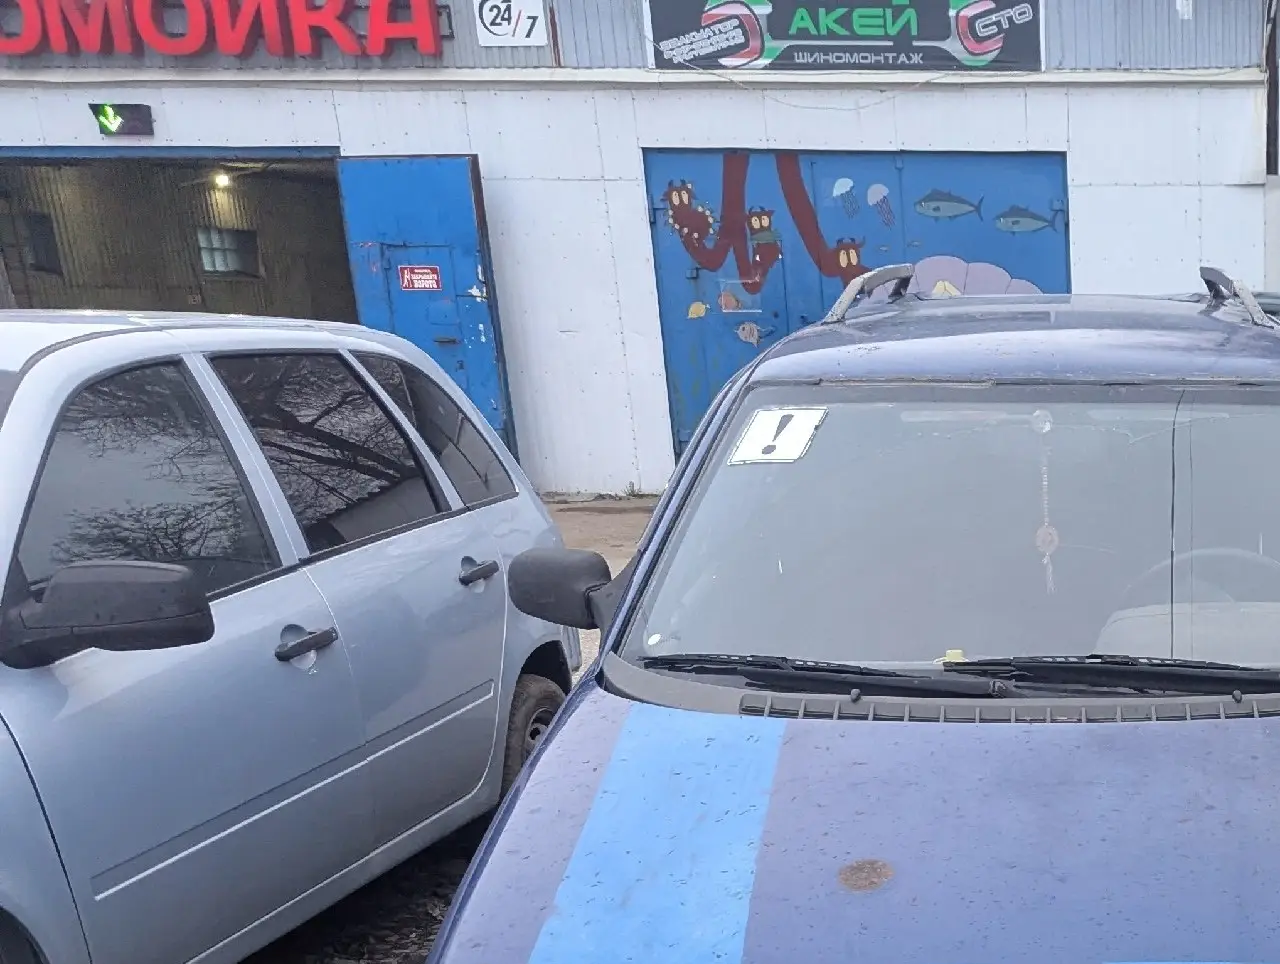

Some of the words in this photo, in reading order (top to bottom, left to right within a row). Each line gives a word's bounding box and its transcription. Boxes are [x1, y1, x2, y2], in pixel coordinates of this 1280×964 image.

[488, 4, 539, 38] 24/7
[788, 0, 919, 37] АКЕЙ
[975, 3, 1034, 37] СТО
[793, 52, 924, 65] ШИНОМОНТАЖ
